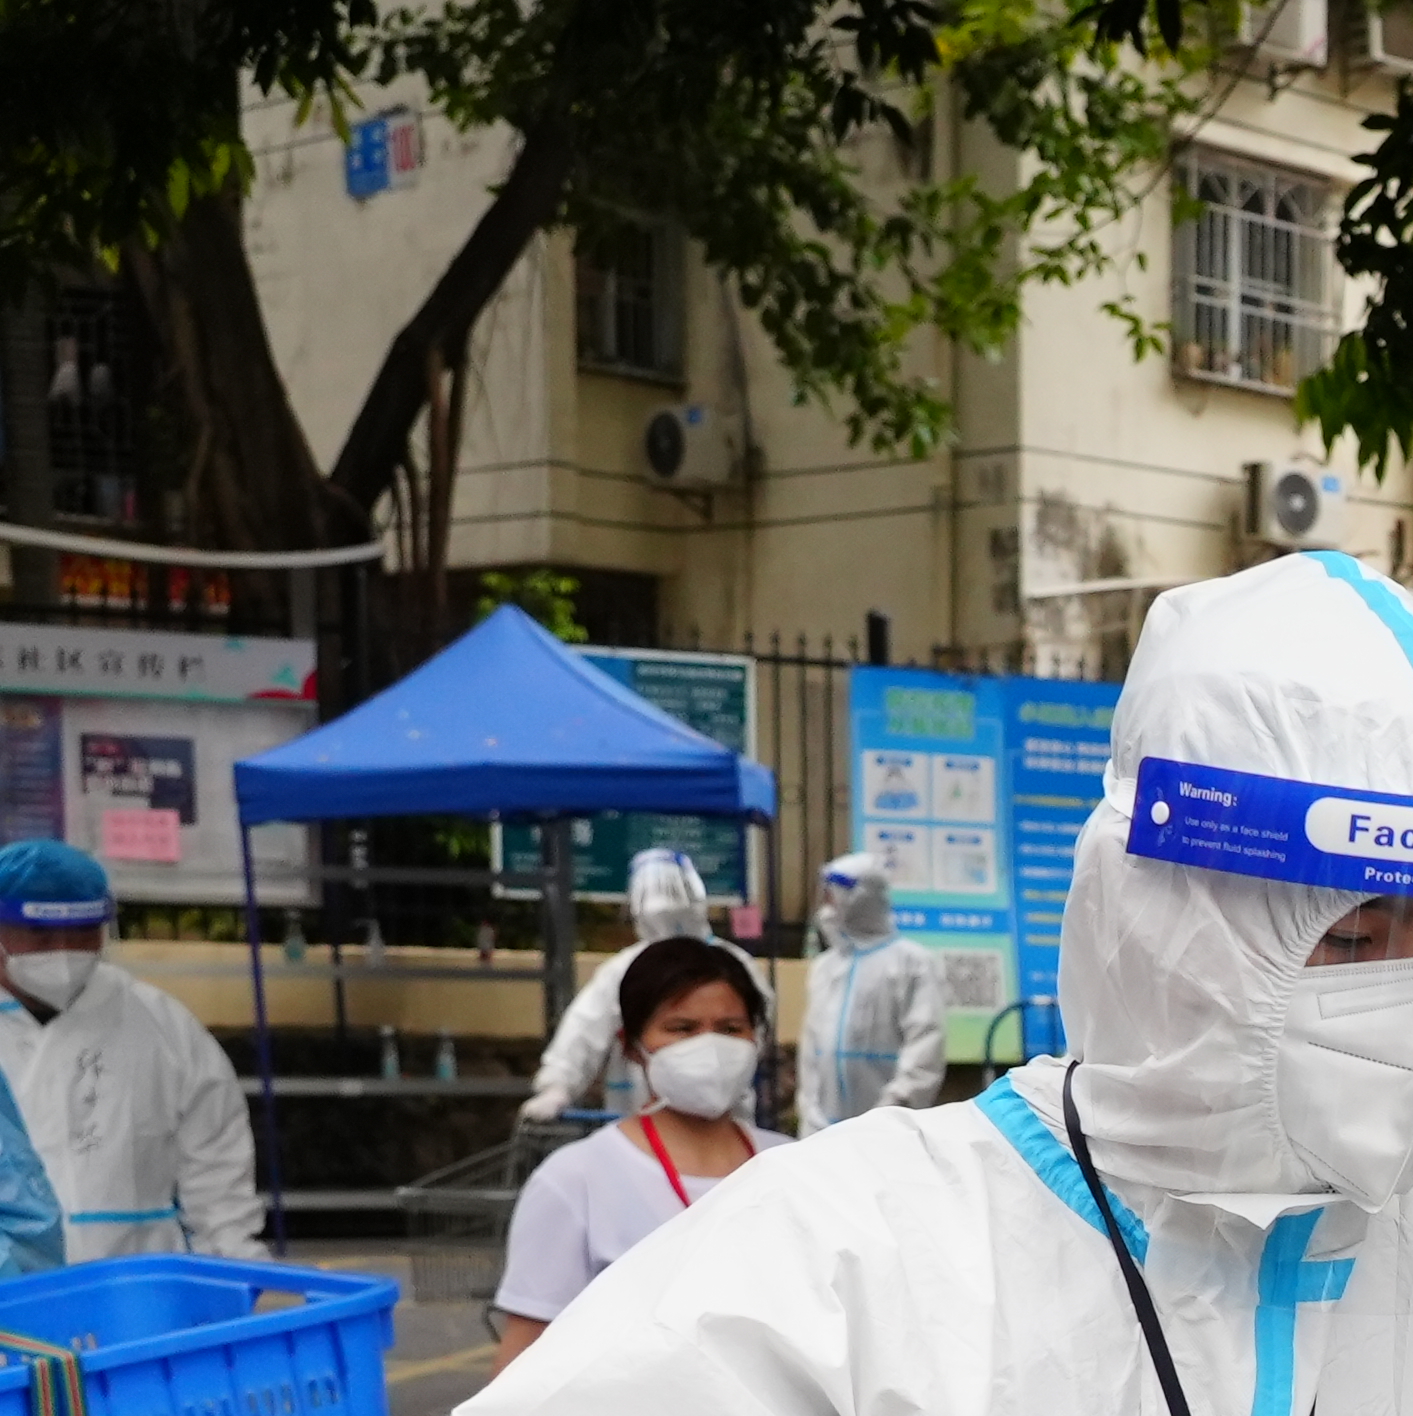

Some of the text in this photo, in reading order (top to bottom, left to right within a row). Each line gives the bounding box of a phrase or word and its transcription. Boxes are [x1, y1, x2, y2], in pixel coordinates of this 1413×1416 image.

[0, 644, 205, 686] 社区宣传栏
[1179, 780, 1238, 807] Warning:
[1261, 829, 1289, 842] shield
